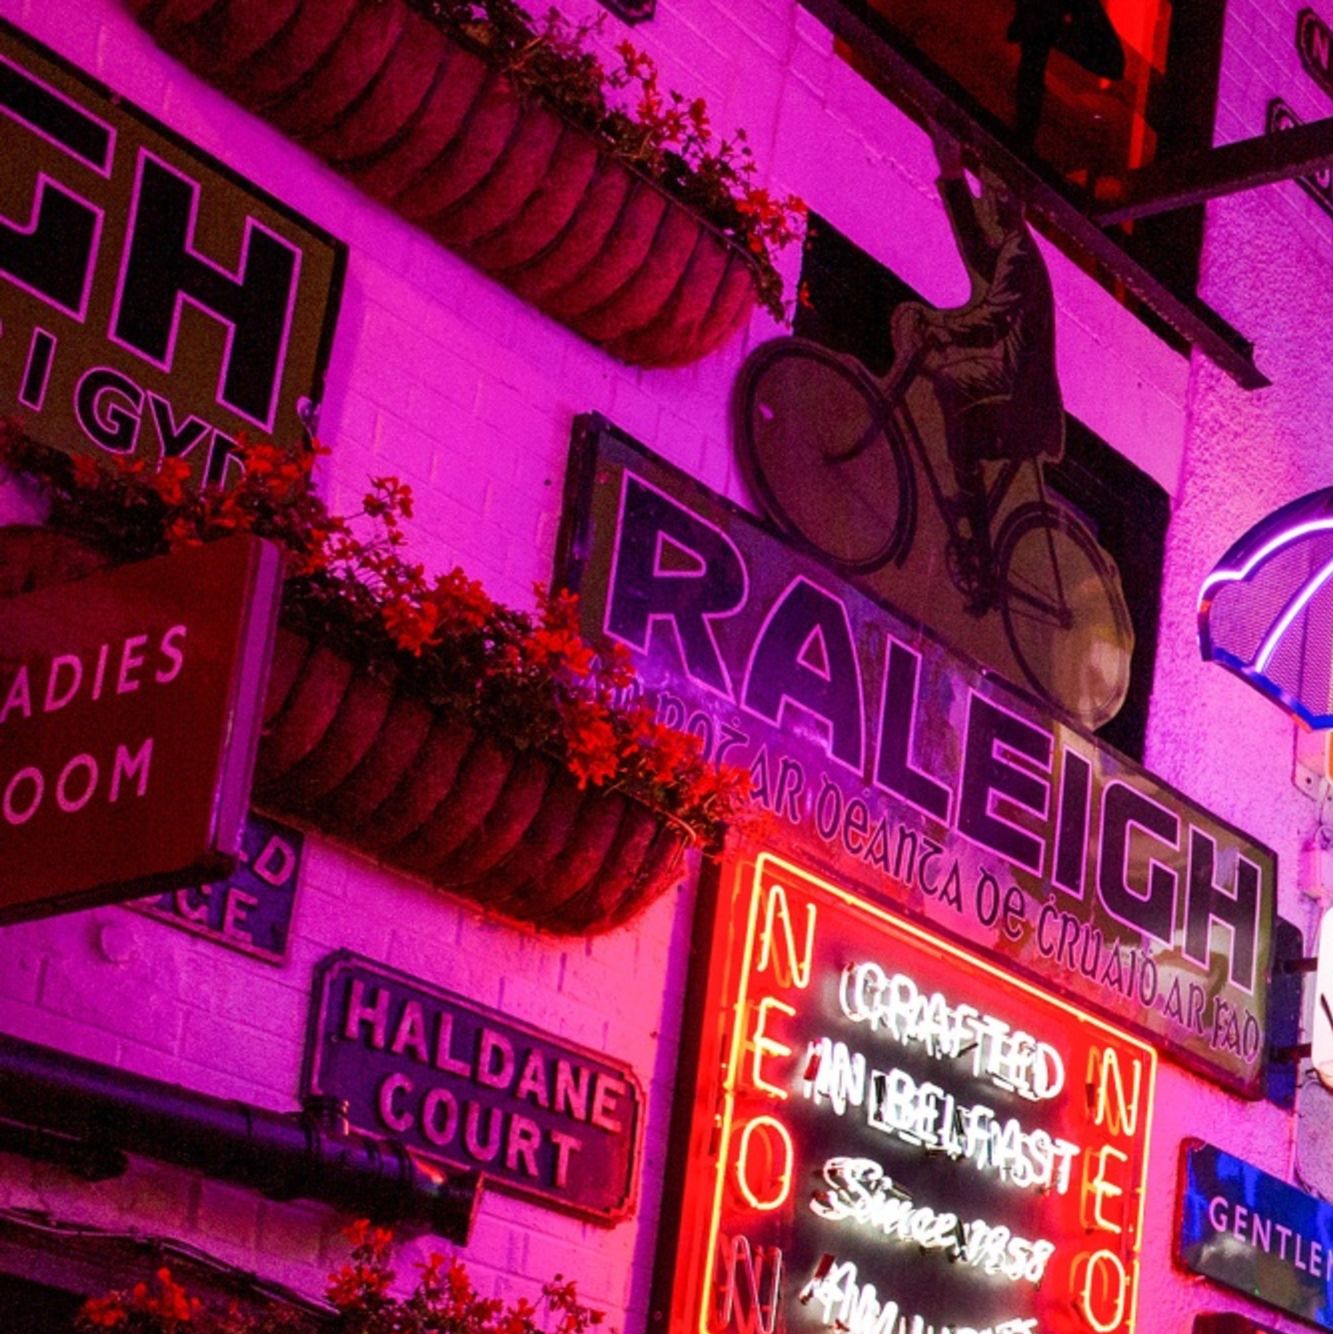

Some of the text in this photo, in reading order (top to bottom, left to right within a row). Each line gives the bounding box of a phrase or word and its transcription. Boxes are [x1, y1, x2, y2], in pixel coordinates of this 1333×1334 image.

[603, 469, 1262, 998] RALEIGH
[345, 980, 628, 1133] HALDANE
[839, 961, 1065, 1103] CRAFTED
[380, 1071, 582, 1189] COURT
[868, 1068, 1081, 1194] BELFAST
